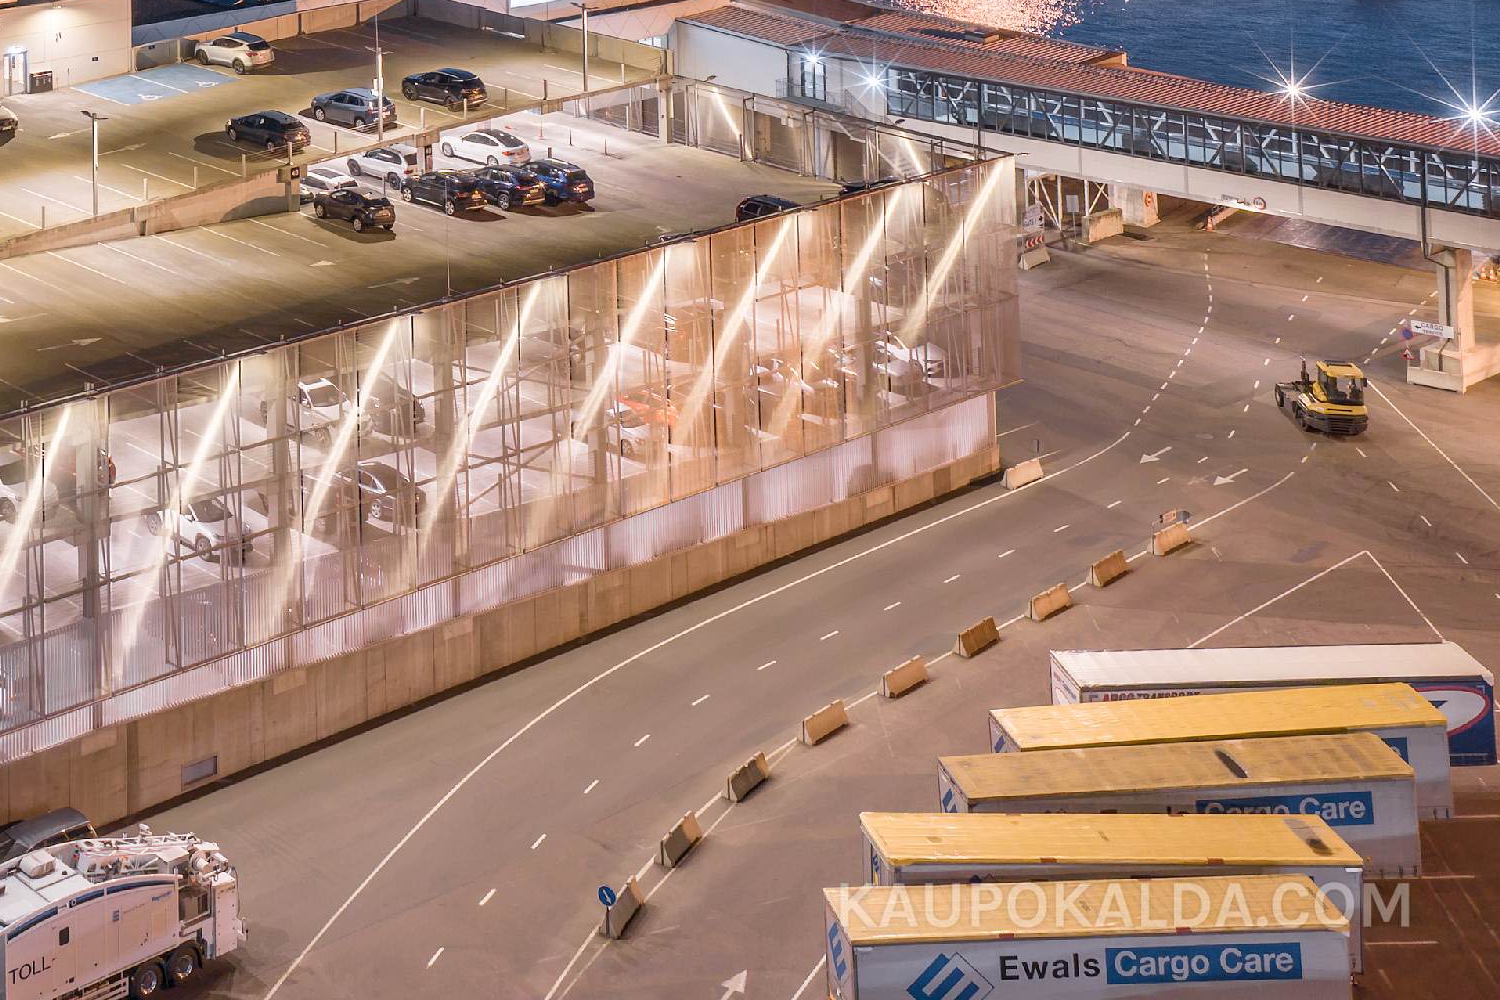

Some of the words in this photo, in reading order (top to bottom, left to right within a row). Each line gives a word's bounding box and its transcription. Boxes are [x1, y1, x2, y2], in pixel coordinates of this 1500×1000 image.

[1300, 797, 1366, 820] Care
[8, 956, 52, 985] TOLL
[999, 953, 1101, 981] Ewals
[1114, 950, 1210, 981] Cargo
[1219, 947, 1294, 975] Care
